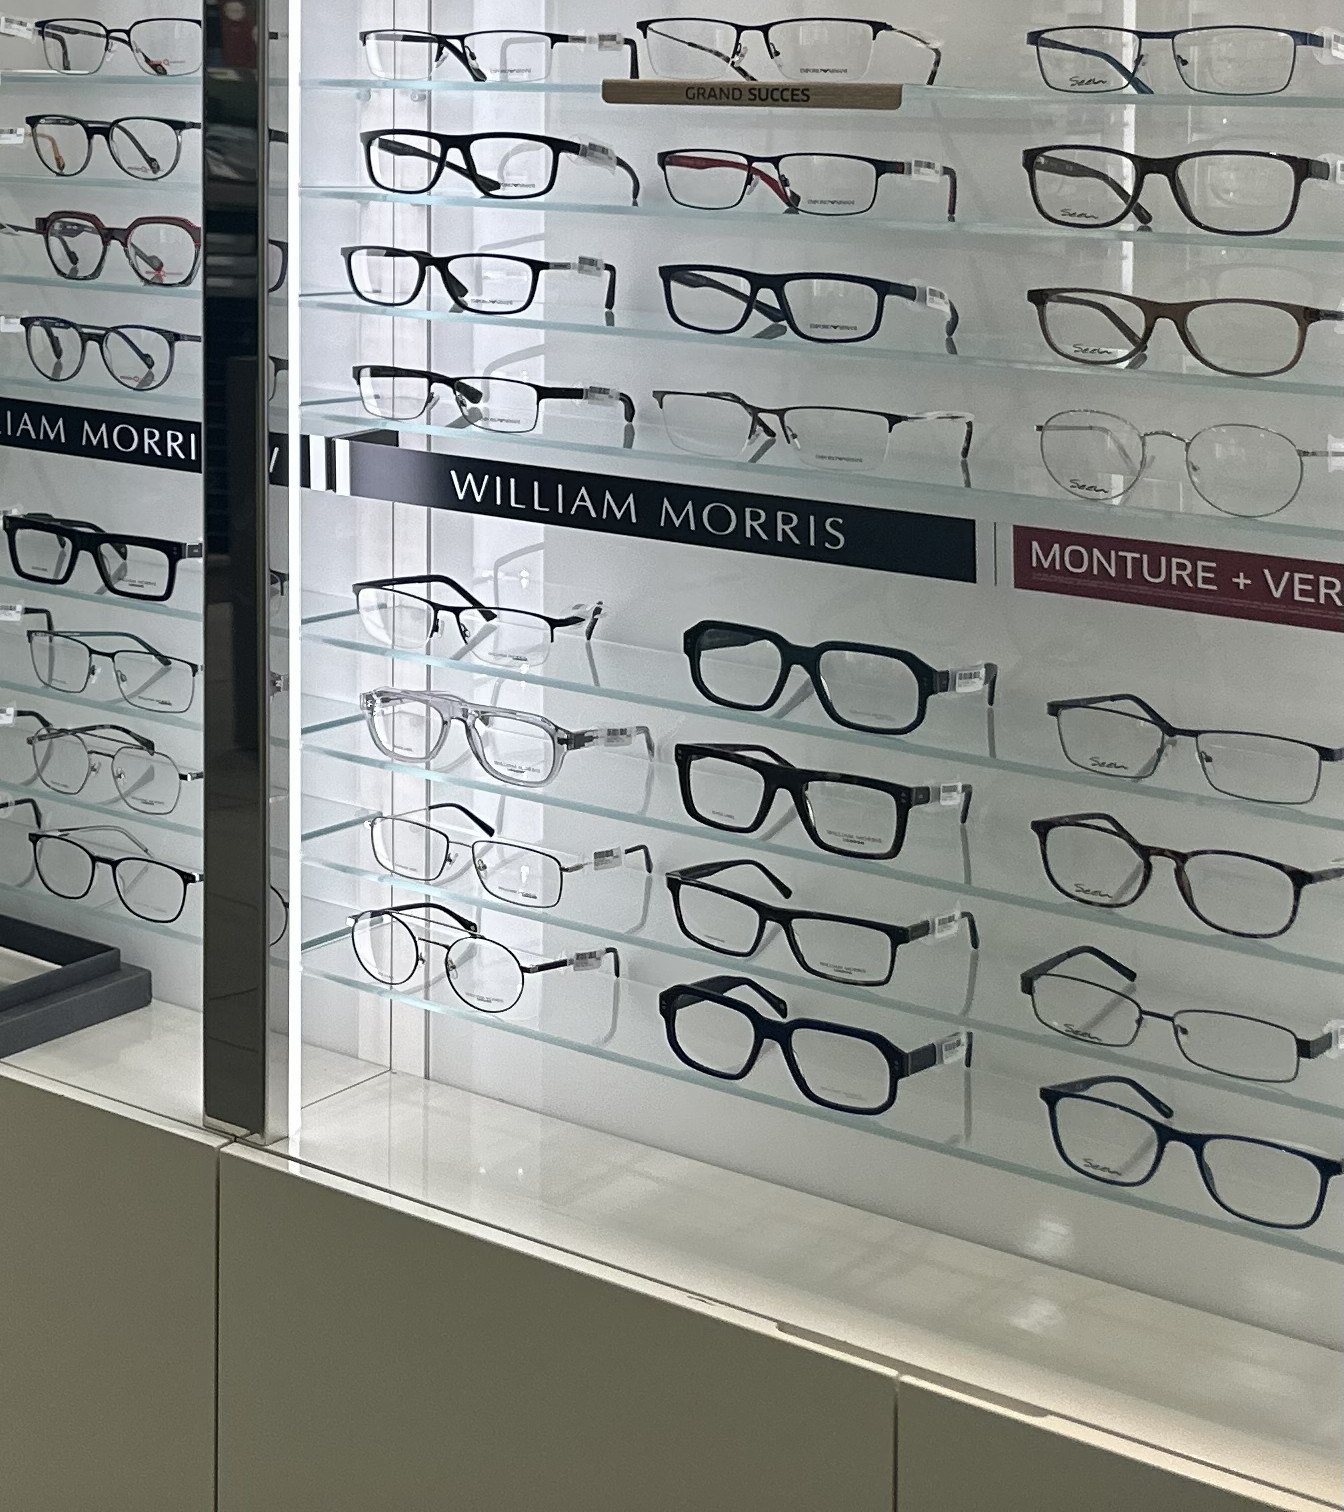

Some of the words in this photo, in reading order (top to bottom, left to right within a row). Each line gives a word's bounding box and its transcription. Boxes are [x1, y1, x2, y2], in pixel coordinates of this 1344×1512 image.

[685, 86, 744, 101] GRAND
[747, 88, 811, 103] SUCCES
[450, 468, 638, 525] WILLIAM
[659, 498, 847, 551] MORRIS
[1030, 540, 1218, 591] MONTURE
[1231, 572, 1252, 590] +
